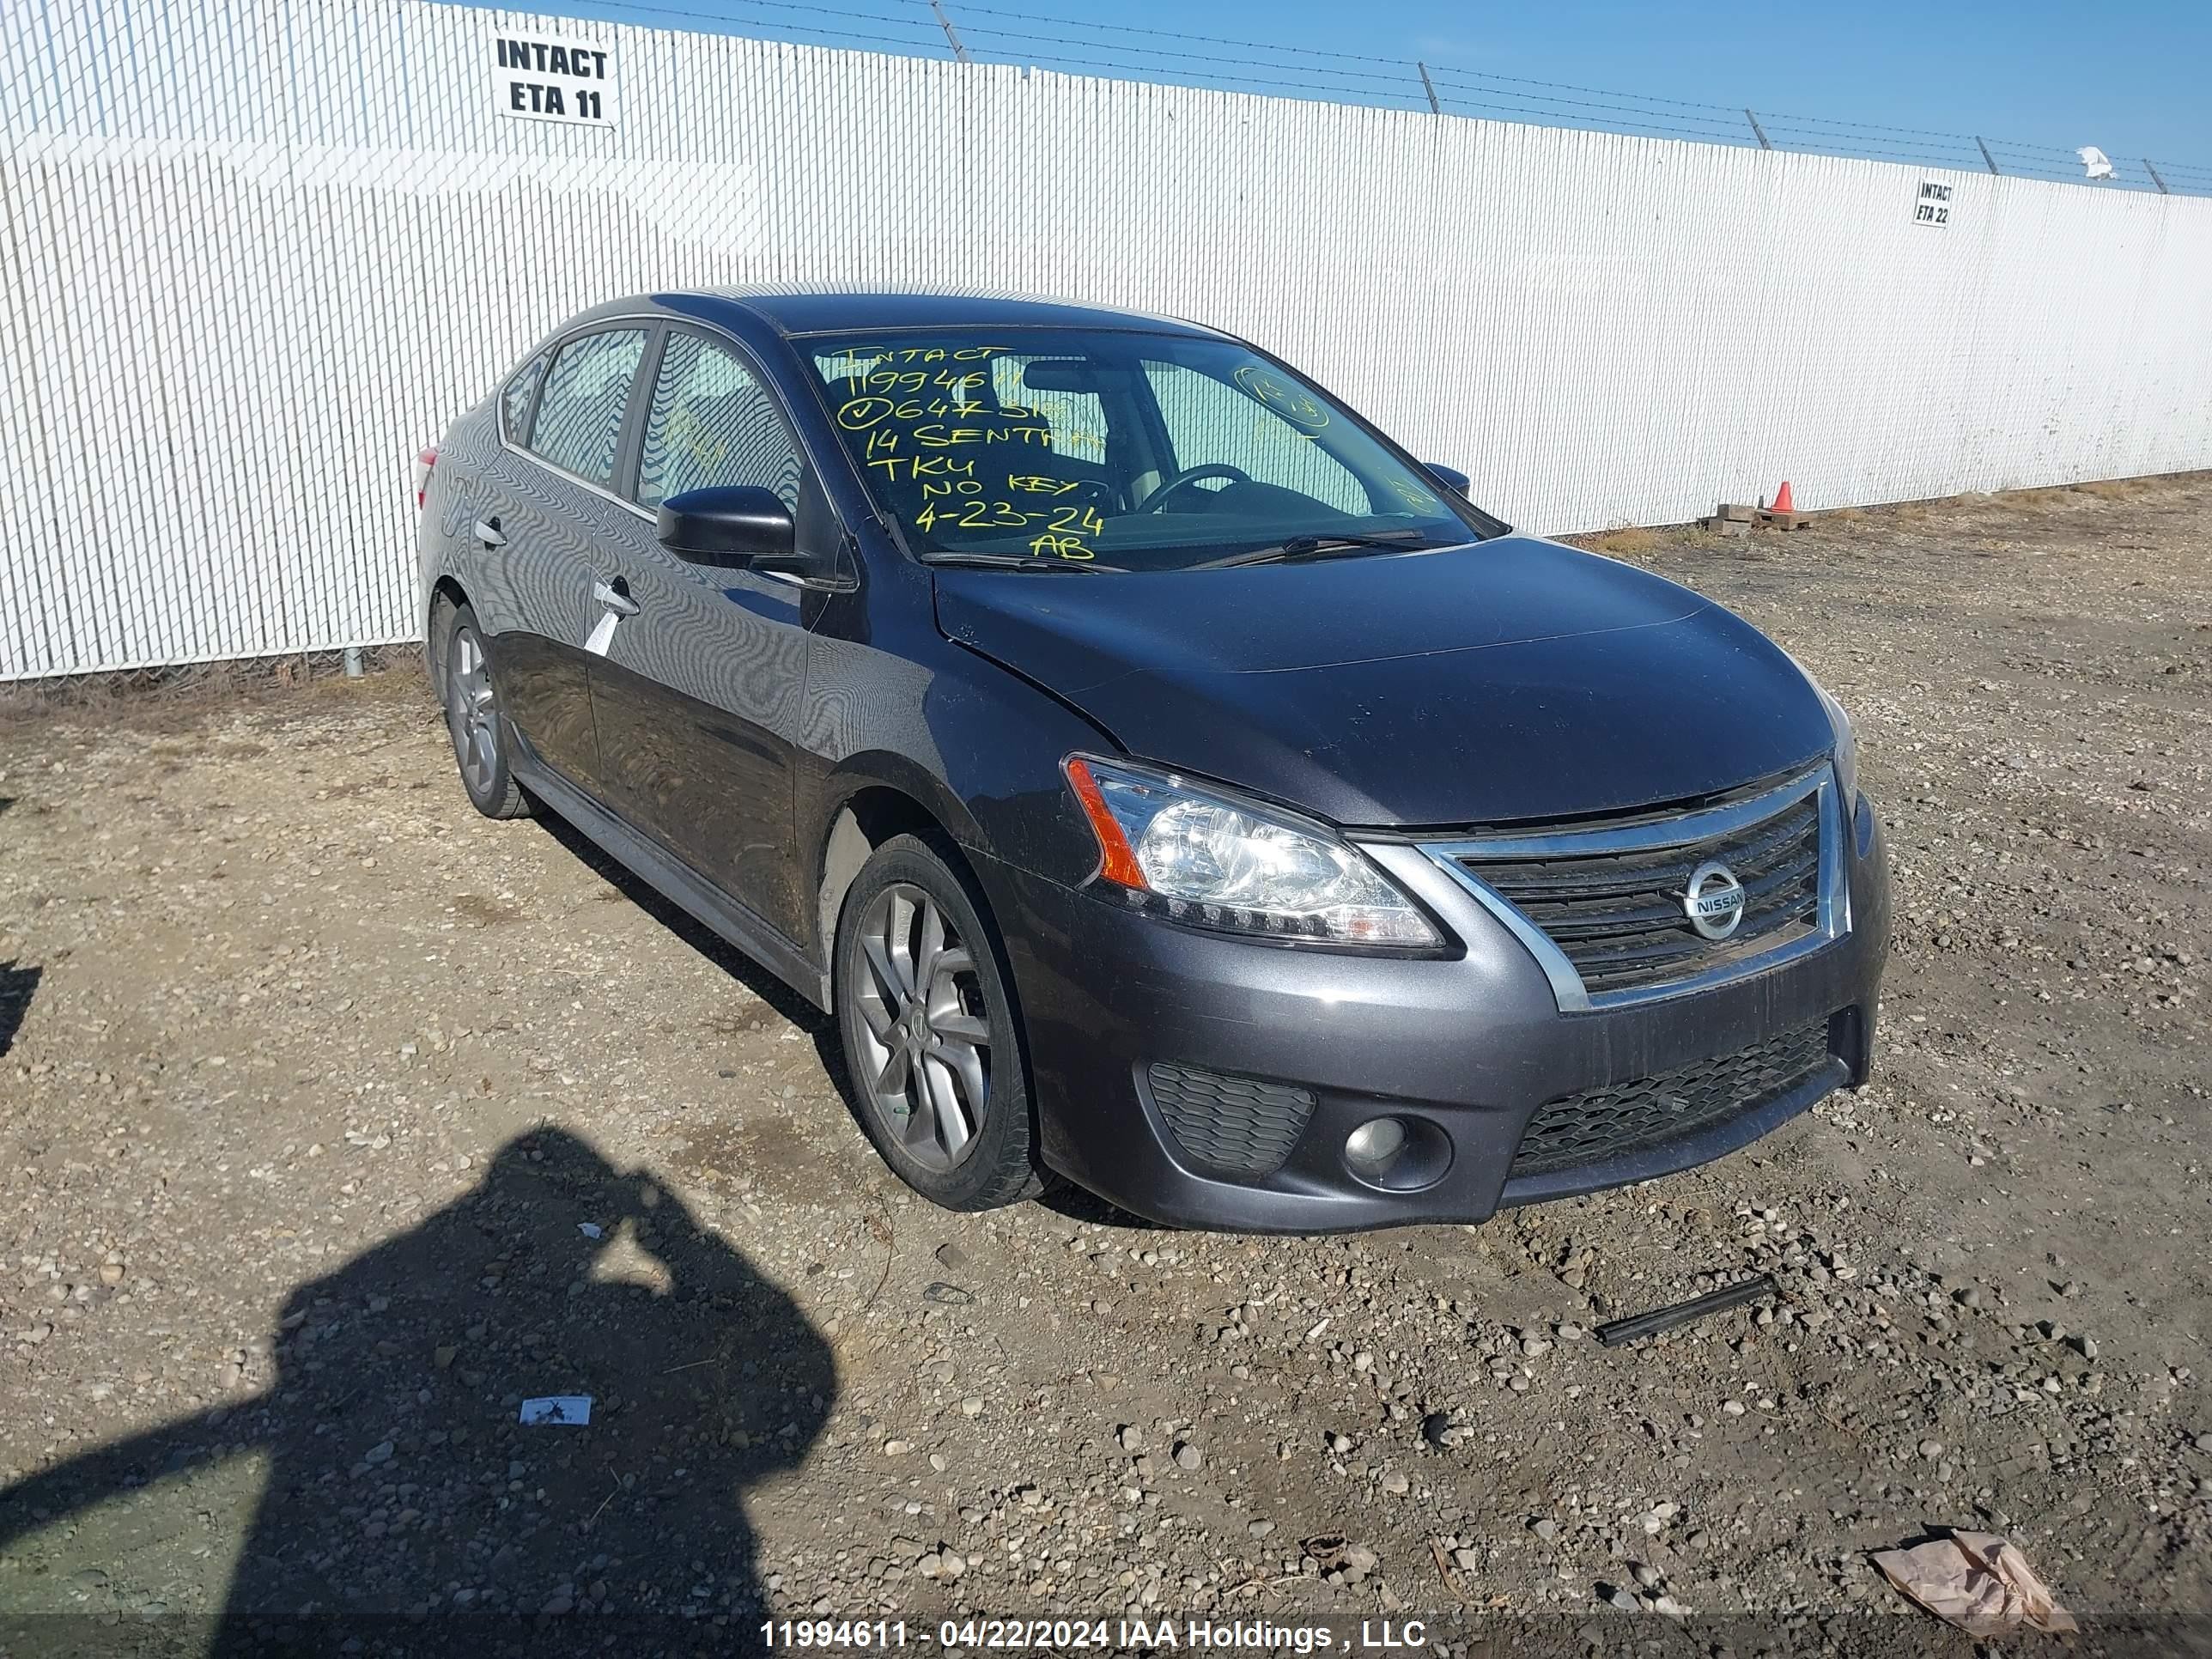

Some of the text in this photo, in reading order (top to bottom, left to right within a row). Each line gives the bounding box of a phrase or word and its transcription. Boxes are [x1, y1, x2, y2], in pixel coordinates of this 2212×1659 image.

[496, 39, 607, 80] INTACT
[509, 82, 601, 119] ETA 11
[1920, 182, 1952, 202] INTACT
[1916, 204, 1948, 223] ETA 22
[831, 346, 1015, 370] INTACT
[866, 428, 898, 459] 14
[923, 474, 1079, 500] NO KEY
[915, 501, 1104, 537] 4-23-24
[1029, 534, 1095, 560] AB
[1697, 892, 1743, 914] NISSAN
